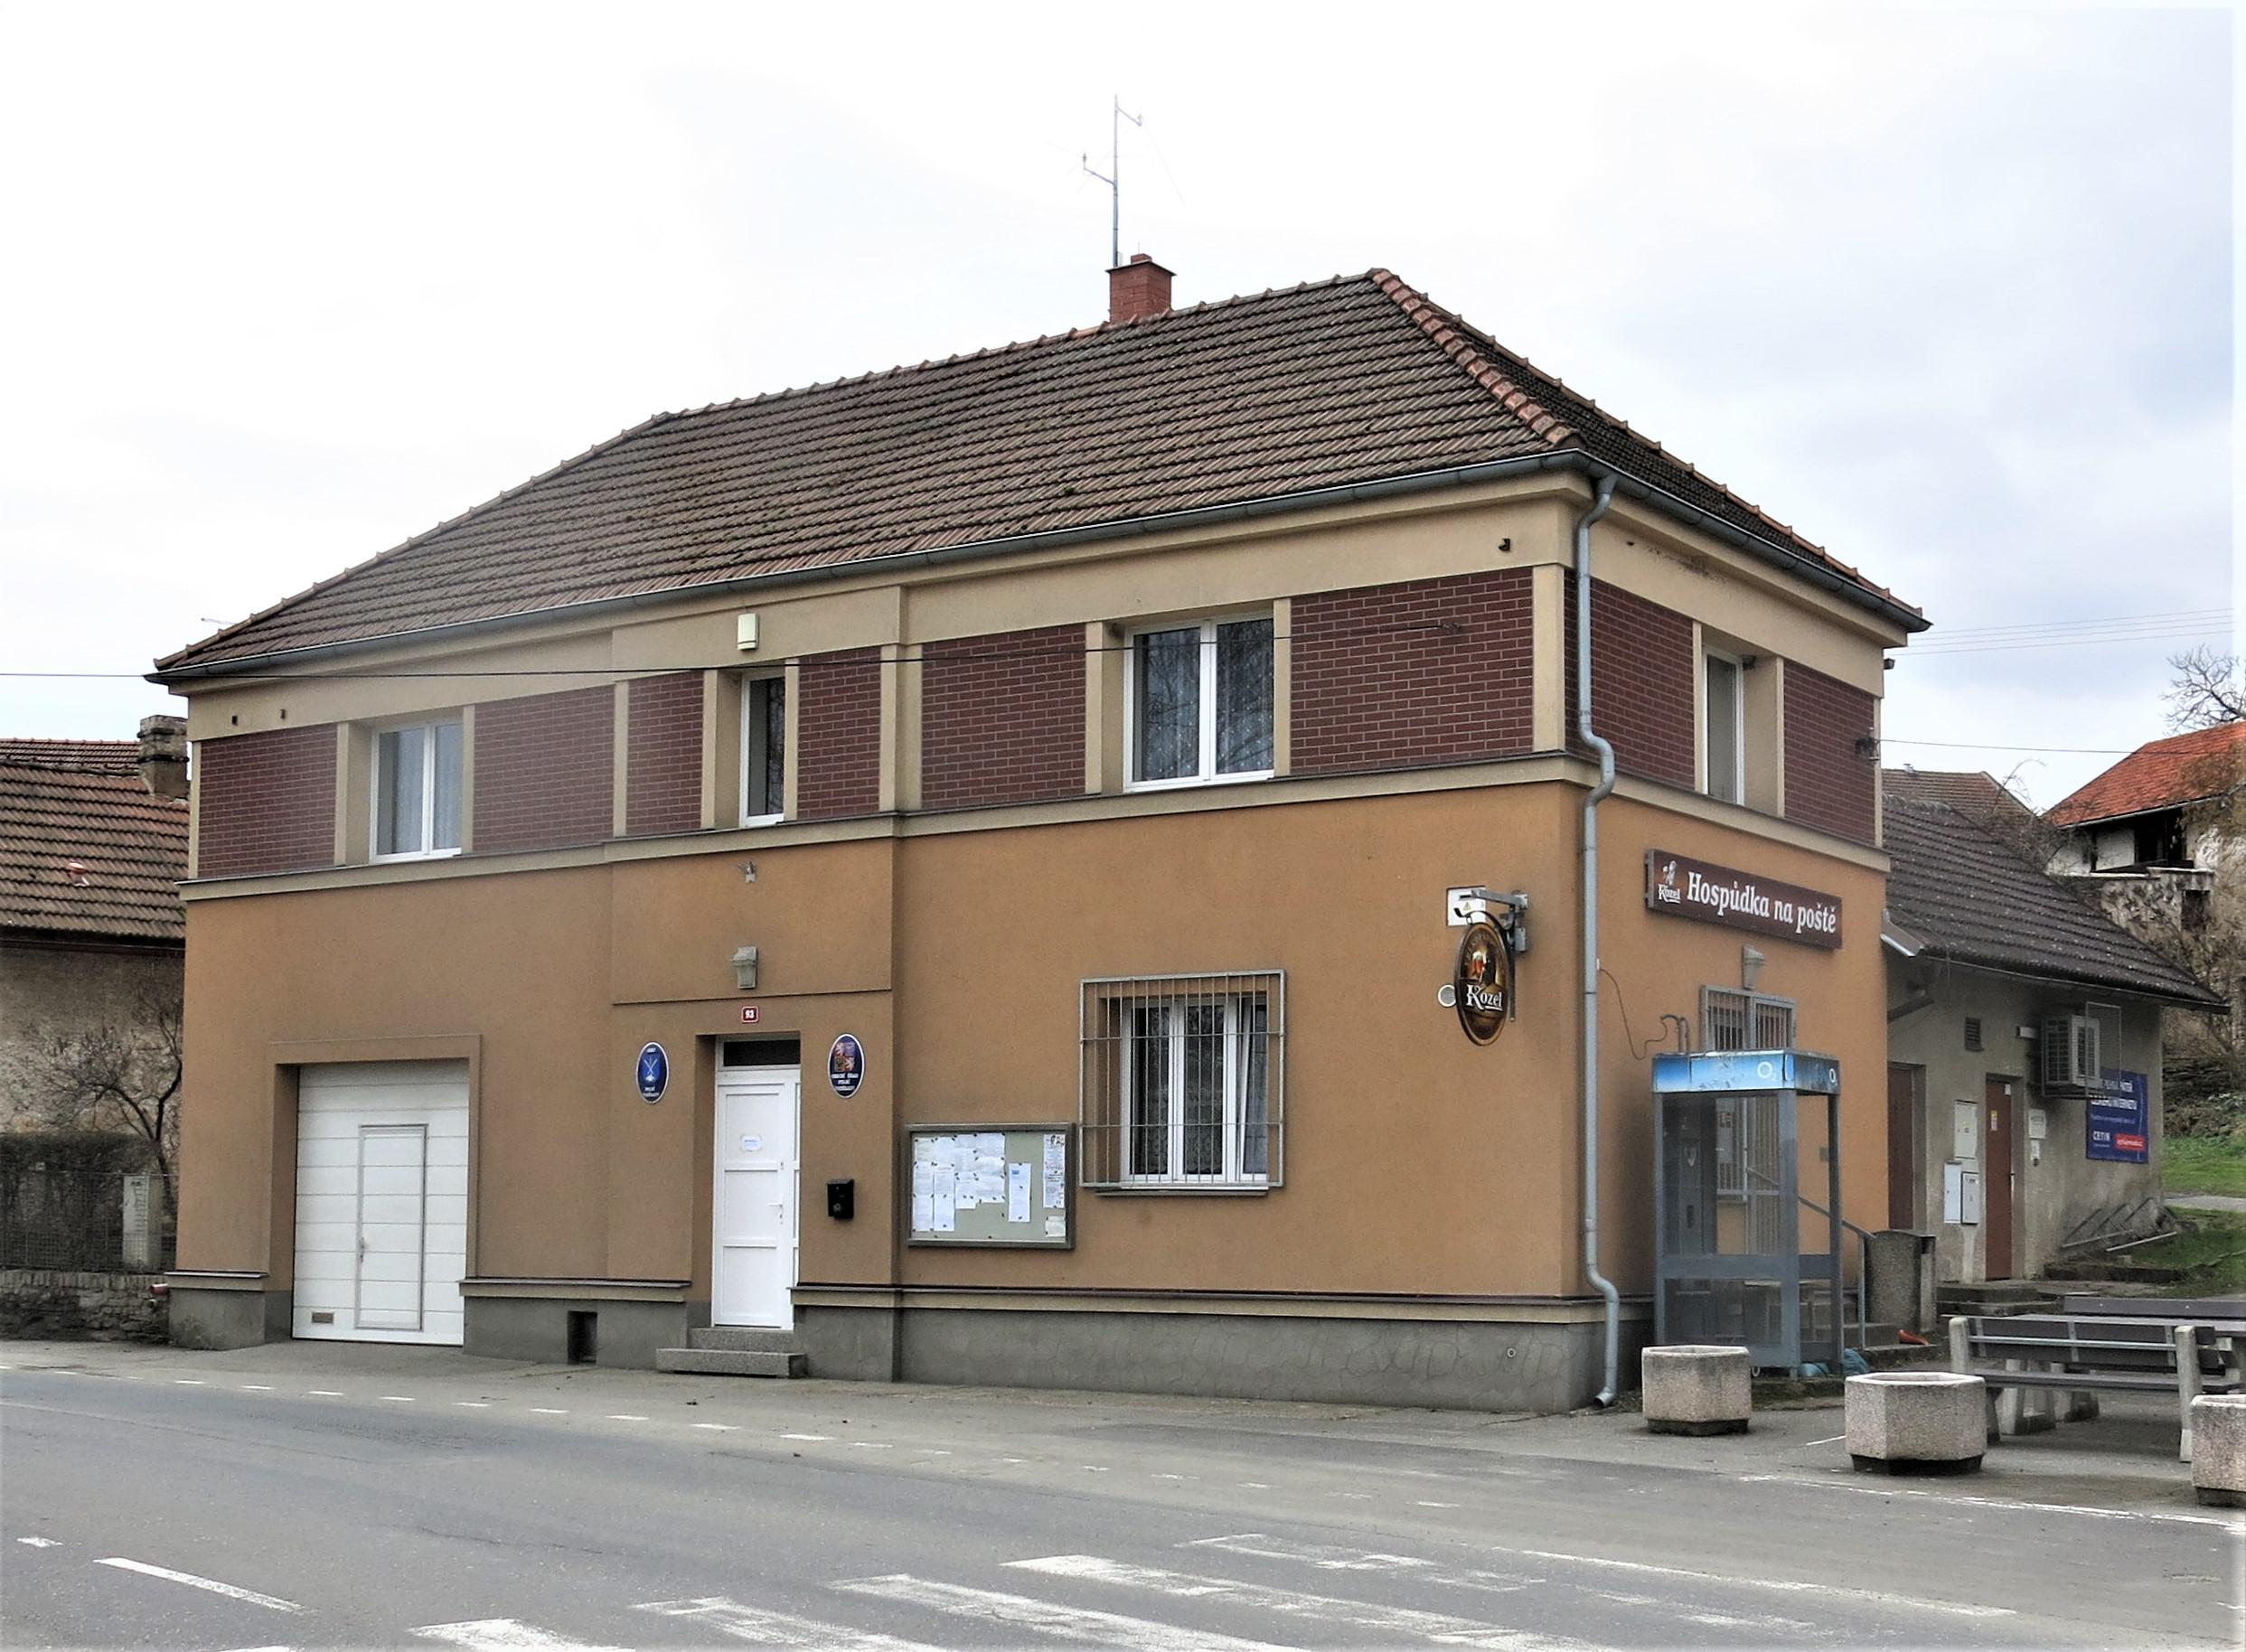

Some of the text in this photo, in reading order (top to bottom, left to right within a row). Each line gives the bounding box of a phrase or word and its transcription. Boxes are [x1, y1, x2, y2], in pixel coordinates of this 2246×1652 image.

[1658, 883, 1681, 904] Kozel
[1687, 870, 1837, 934] Hospůdka na poště
[1466, 984, 1503, 1011] Kozel
